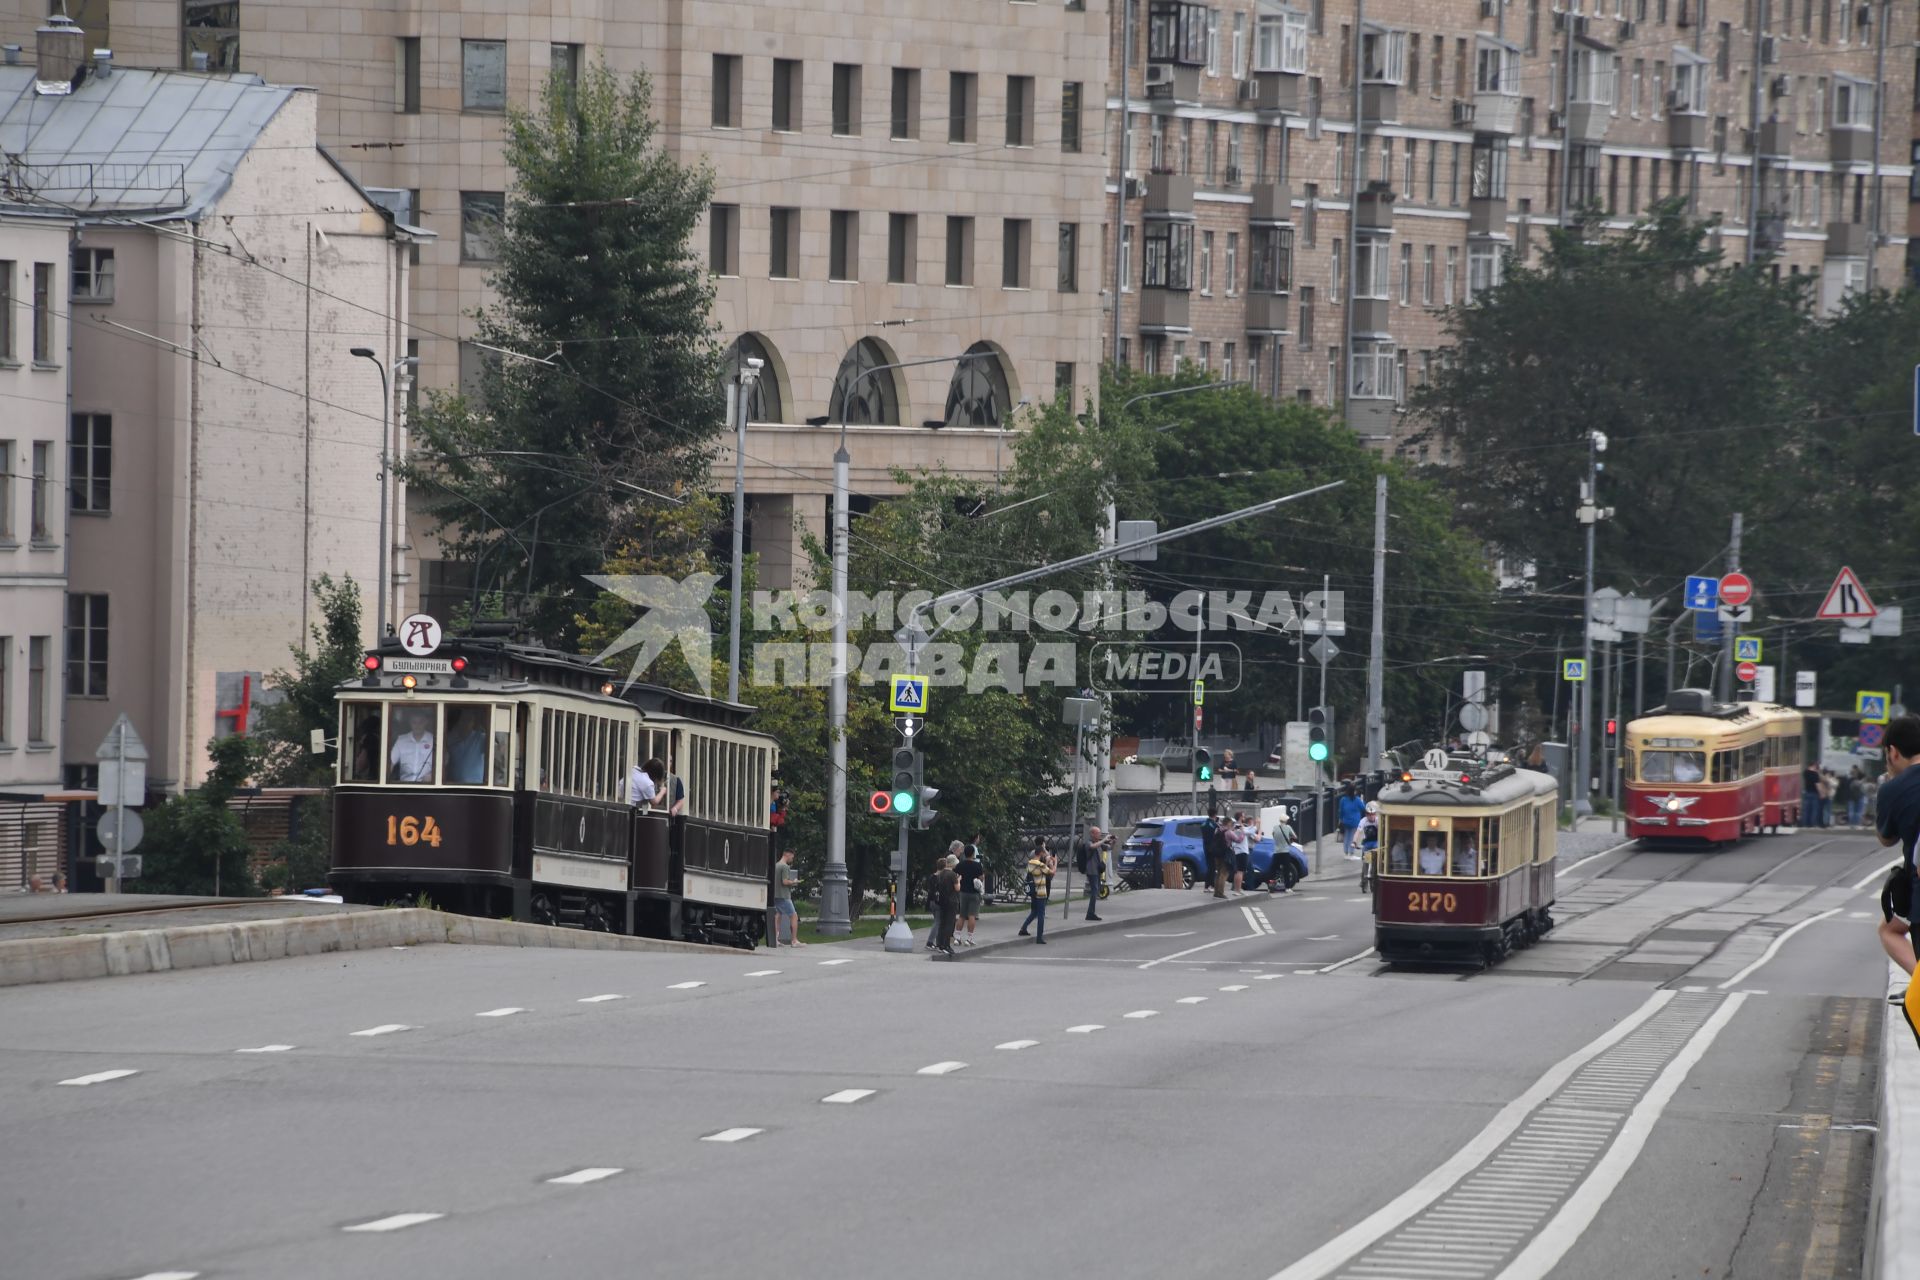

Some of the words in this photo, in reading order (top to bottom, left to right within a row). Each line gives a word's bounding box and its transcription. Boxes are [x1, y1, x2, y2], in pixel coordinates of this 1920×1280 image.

[1428, 752, 1443, 769] 41
[387, 815, 442, 847] 164
[1408, 892, 1456, 912] 2170
